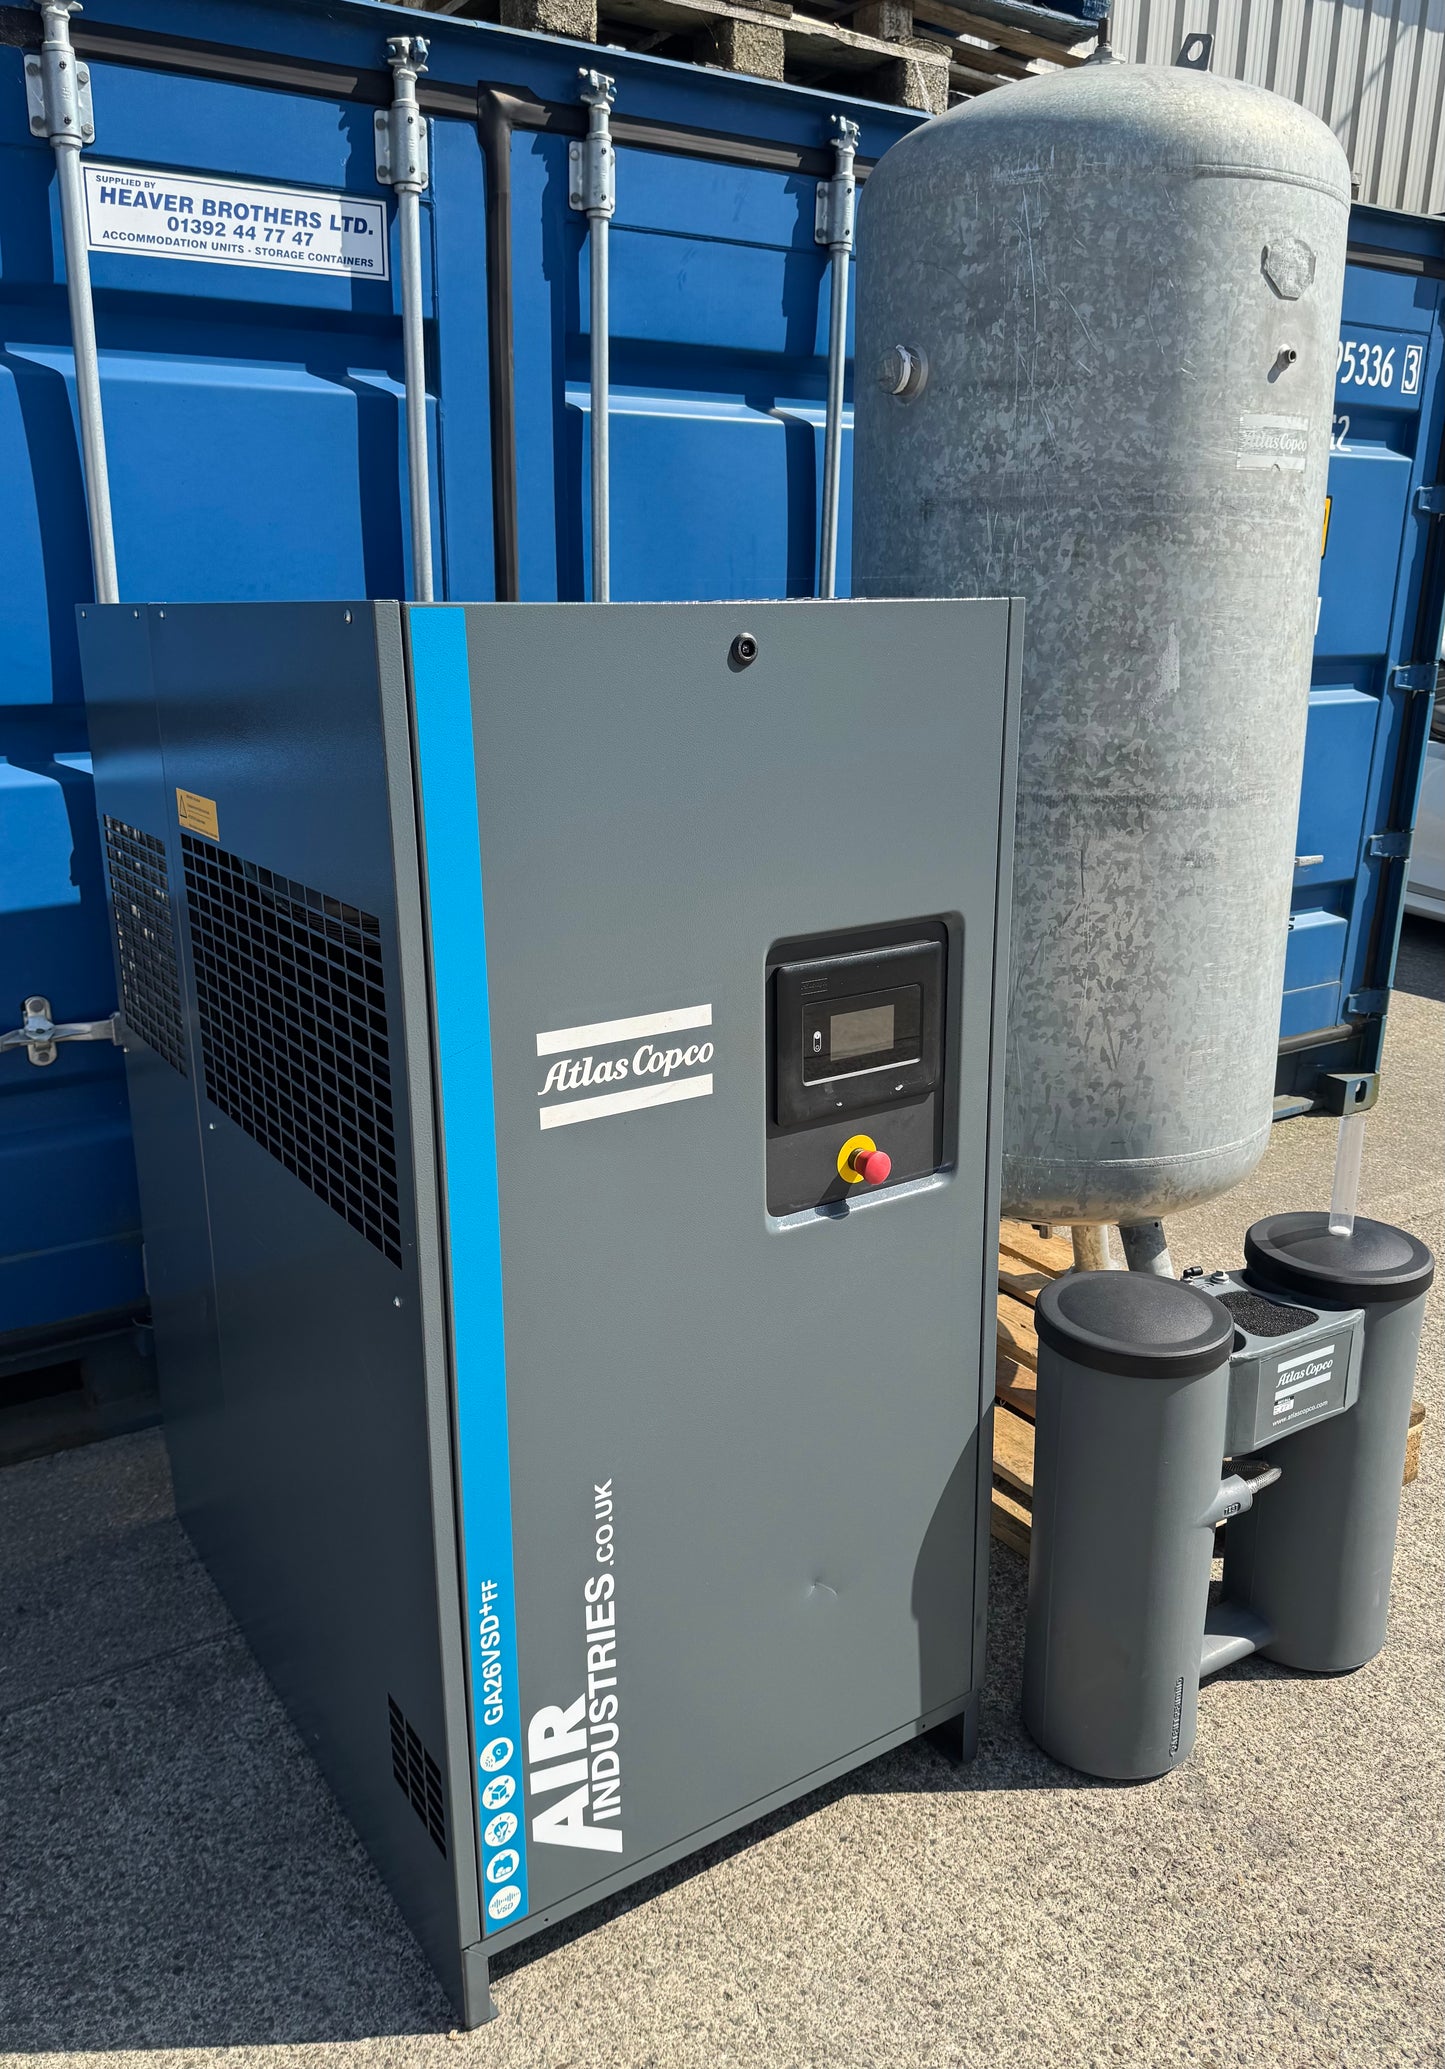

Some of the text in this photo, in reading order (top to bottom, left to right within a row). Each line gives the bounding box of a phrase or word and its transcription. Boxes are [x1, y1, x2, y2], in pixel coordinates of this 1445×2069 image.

[95, 174, 156, 189] SUPPLIED BY
[100, 186, 374, 236] HEAVER BROTHERS LTD.
[167, 216, 314, 247] 01392 44 77 47
[102, 230, 207, 249] ACCOMMODATION
[211, 242, 245, 253] UNITS
[254, 246, 305, 260] STORAGE
[307, 252, 374, 267] CONTAINERS
[1403, 348, 1420, 391] 3
[1280, 432, 1308, 454] Copco
[537, 1042, 714, 1096] Atlas Copco
[1275, 1359, 1334, 1389] Atlas Copco
[1272, 1400, 1329, 1427] www.atlascopco.com
[528, 1693, 623, 1853] AIR
[497, 1902, 514, 1915] VSD
